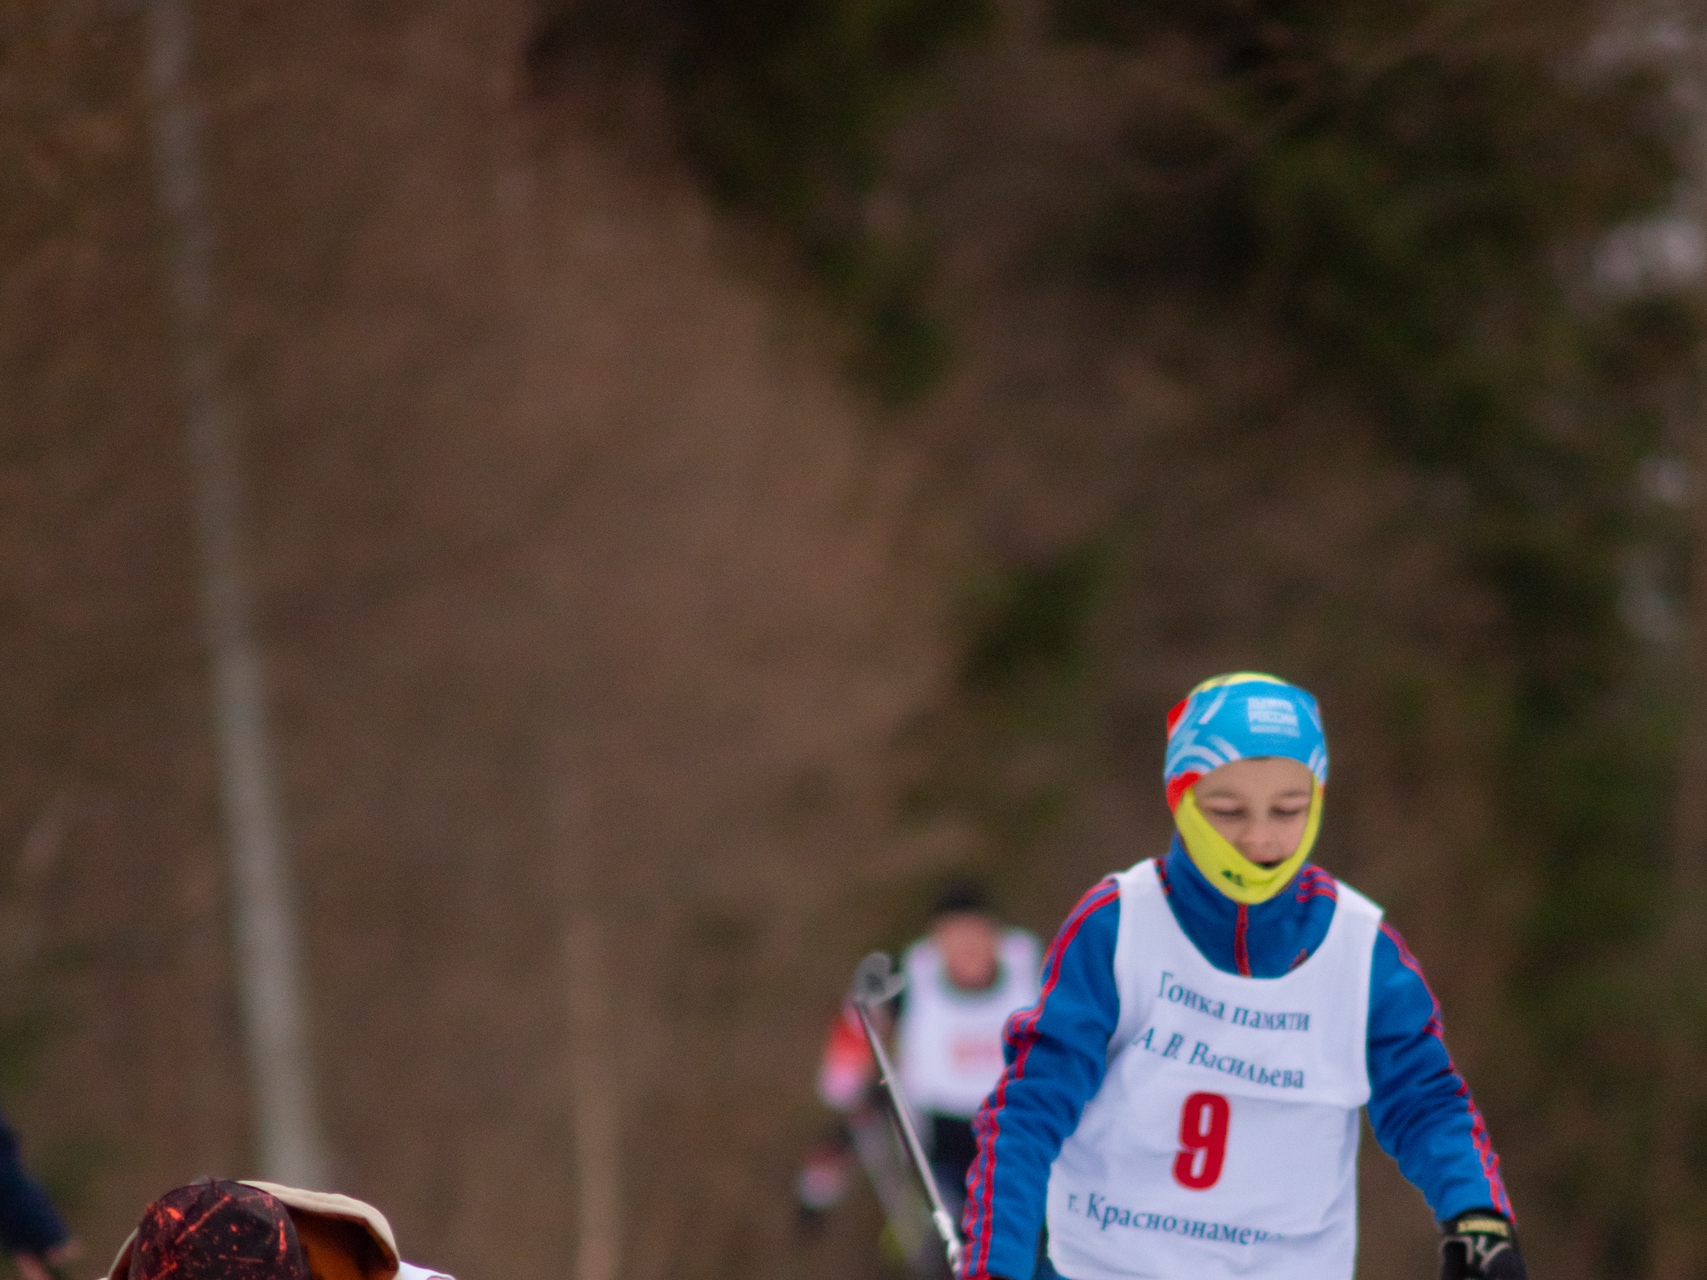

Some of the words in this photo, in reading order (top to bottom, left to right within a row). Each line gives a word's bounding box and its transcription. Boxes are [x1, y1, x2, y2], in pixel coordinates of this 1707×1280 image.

[1158, 970, 1225, 1020] Гонка
[1231, 1006, 1310, 1031] памяти
[1162, 1032, 1184, 1060] В.
[1188, 1041, 1304, 1089] Васильева
[1172, 1091, 1230, 1190] 9
